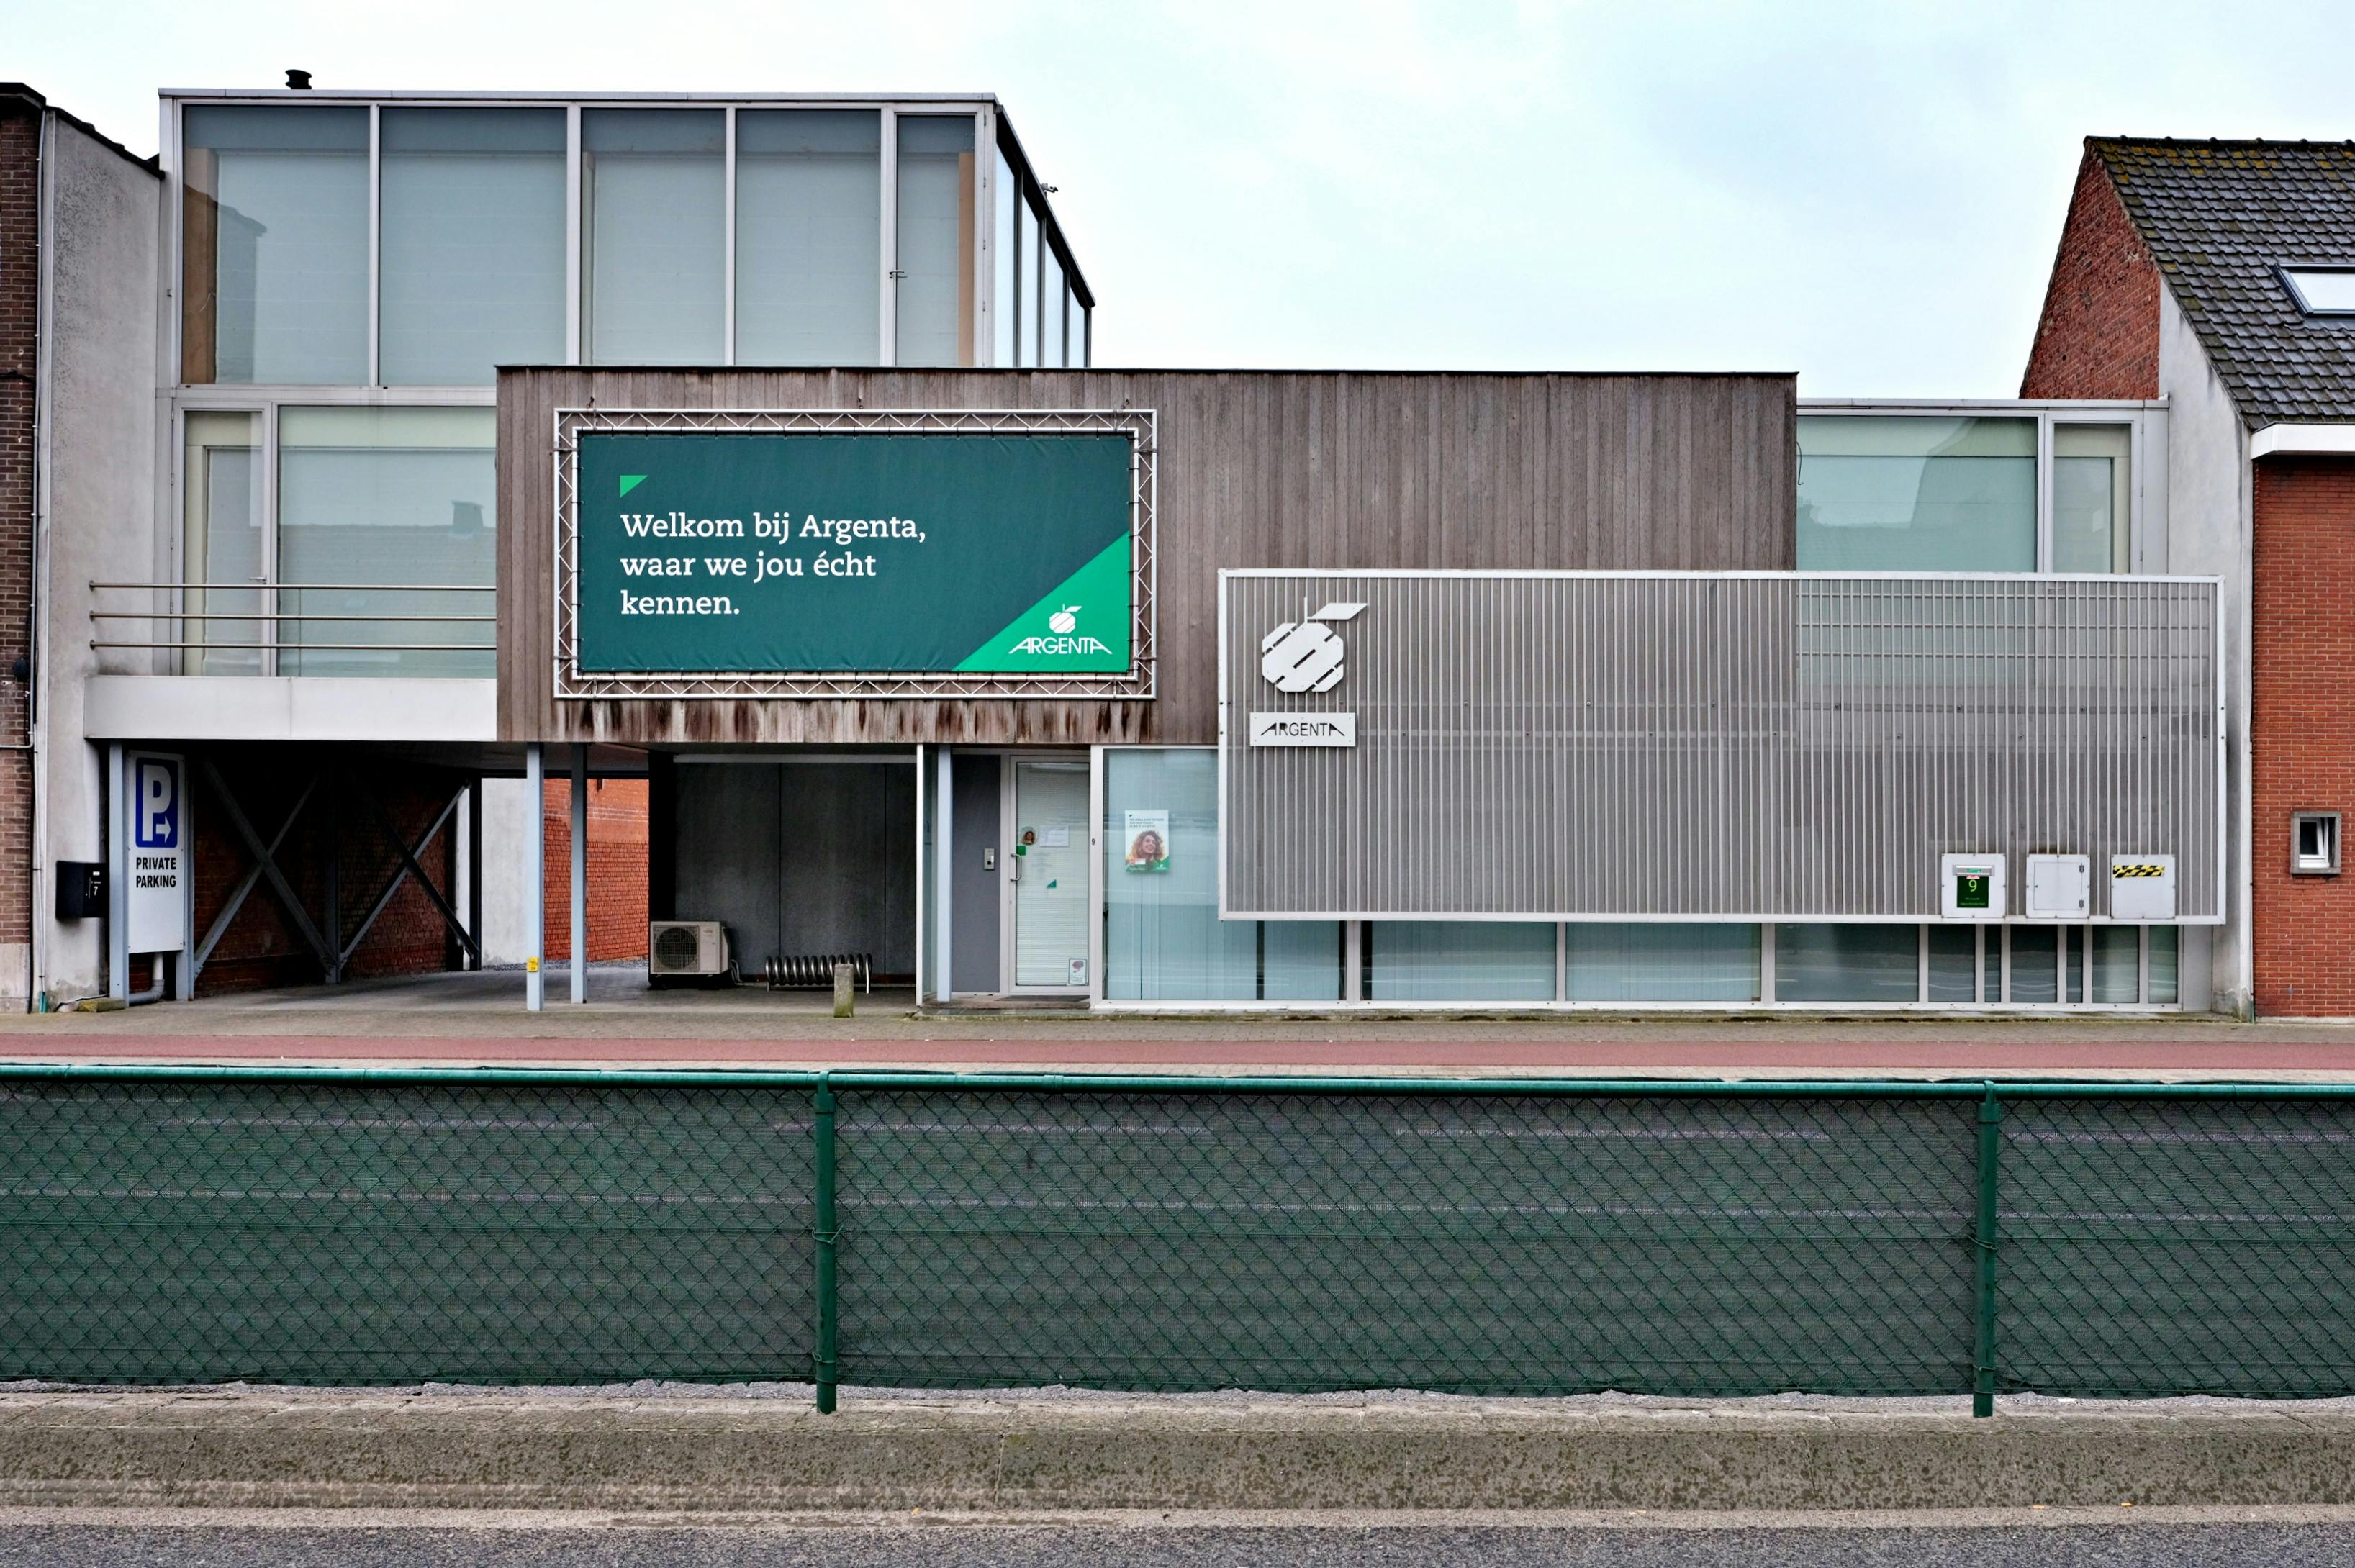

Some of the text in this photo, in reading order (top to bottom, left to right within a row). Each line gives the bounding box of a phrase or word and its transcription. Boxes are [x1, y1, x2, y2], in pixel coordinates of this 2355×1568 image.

[620, 512, 926, 545] Welkom bij Argenta,
[620, 550, 877, 584] waar we jou écht
[620, 589, 741, 615] kennen.
[1008, 637, 1113, 655] ARGENTA
[1261, 722, 1345, 736] ARGENTA
[142, 764, 172, 842] P
[136, 856, 176, 870] PRIVATE
[136, 874, 176, 889] PARKING
[1968, 879, 1978, 892] 9
[94, 886, 99, 896] 7
